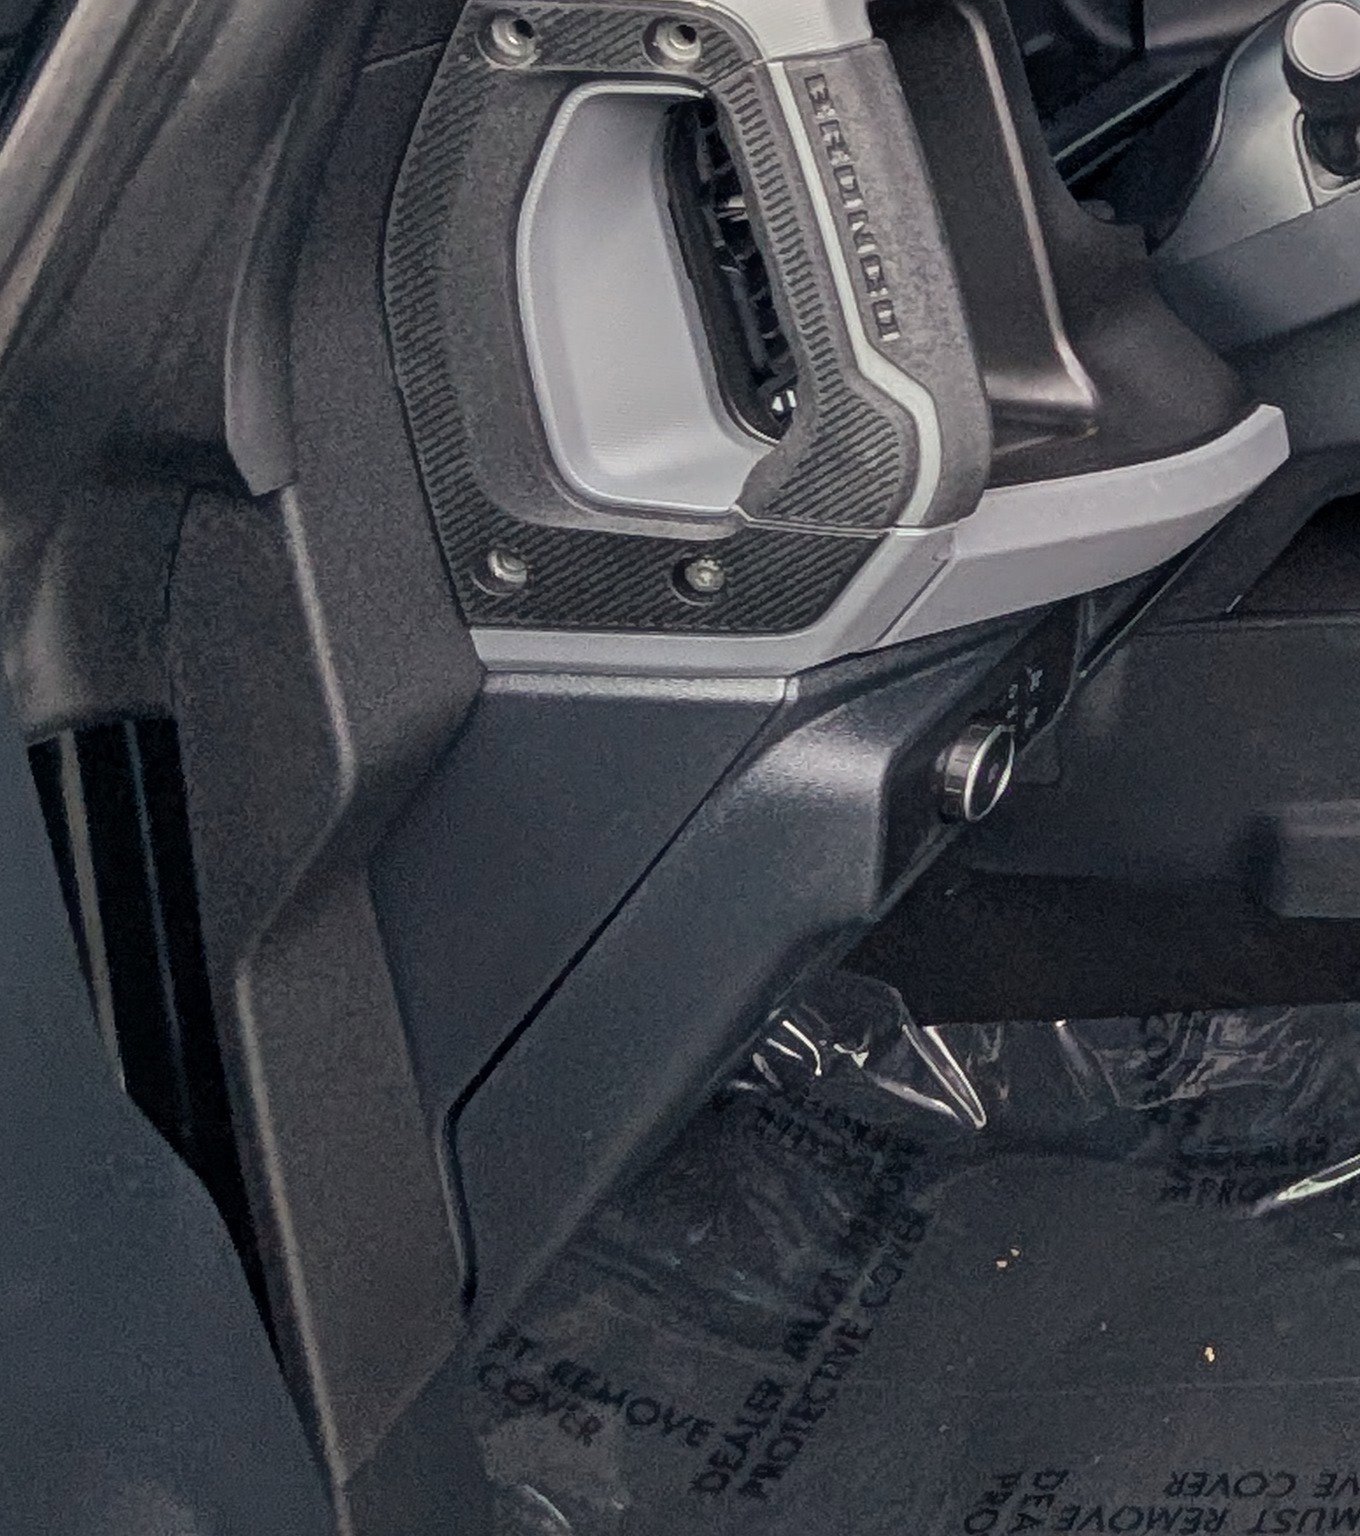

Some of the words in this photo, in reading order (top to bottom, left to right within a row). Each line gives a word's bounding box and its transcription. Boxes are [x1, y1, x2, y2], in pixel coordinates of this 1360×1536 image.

[804, 73, 902, 342] BRONCO
[1164, 1468, 1297, 1499] COVER
[1056, 1501, 1226, 1533] REMOVE
